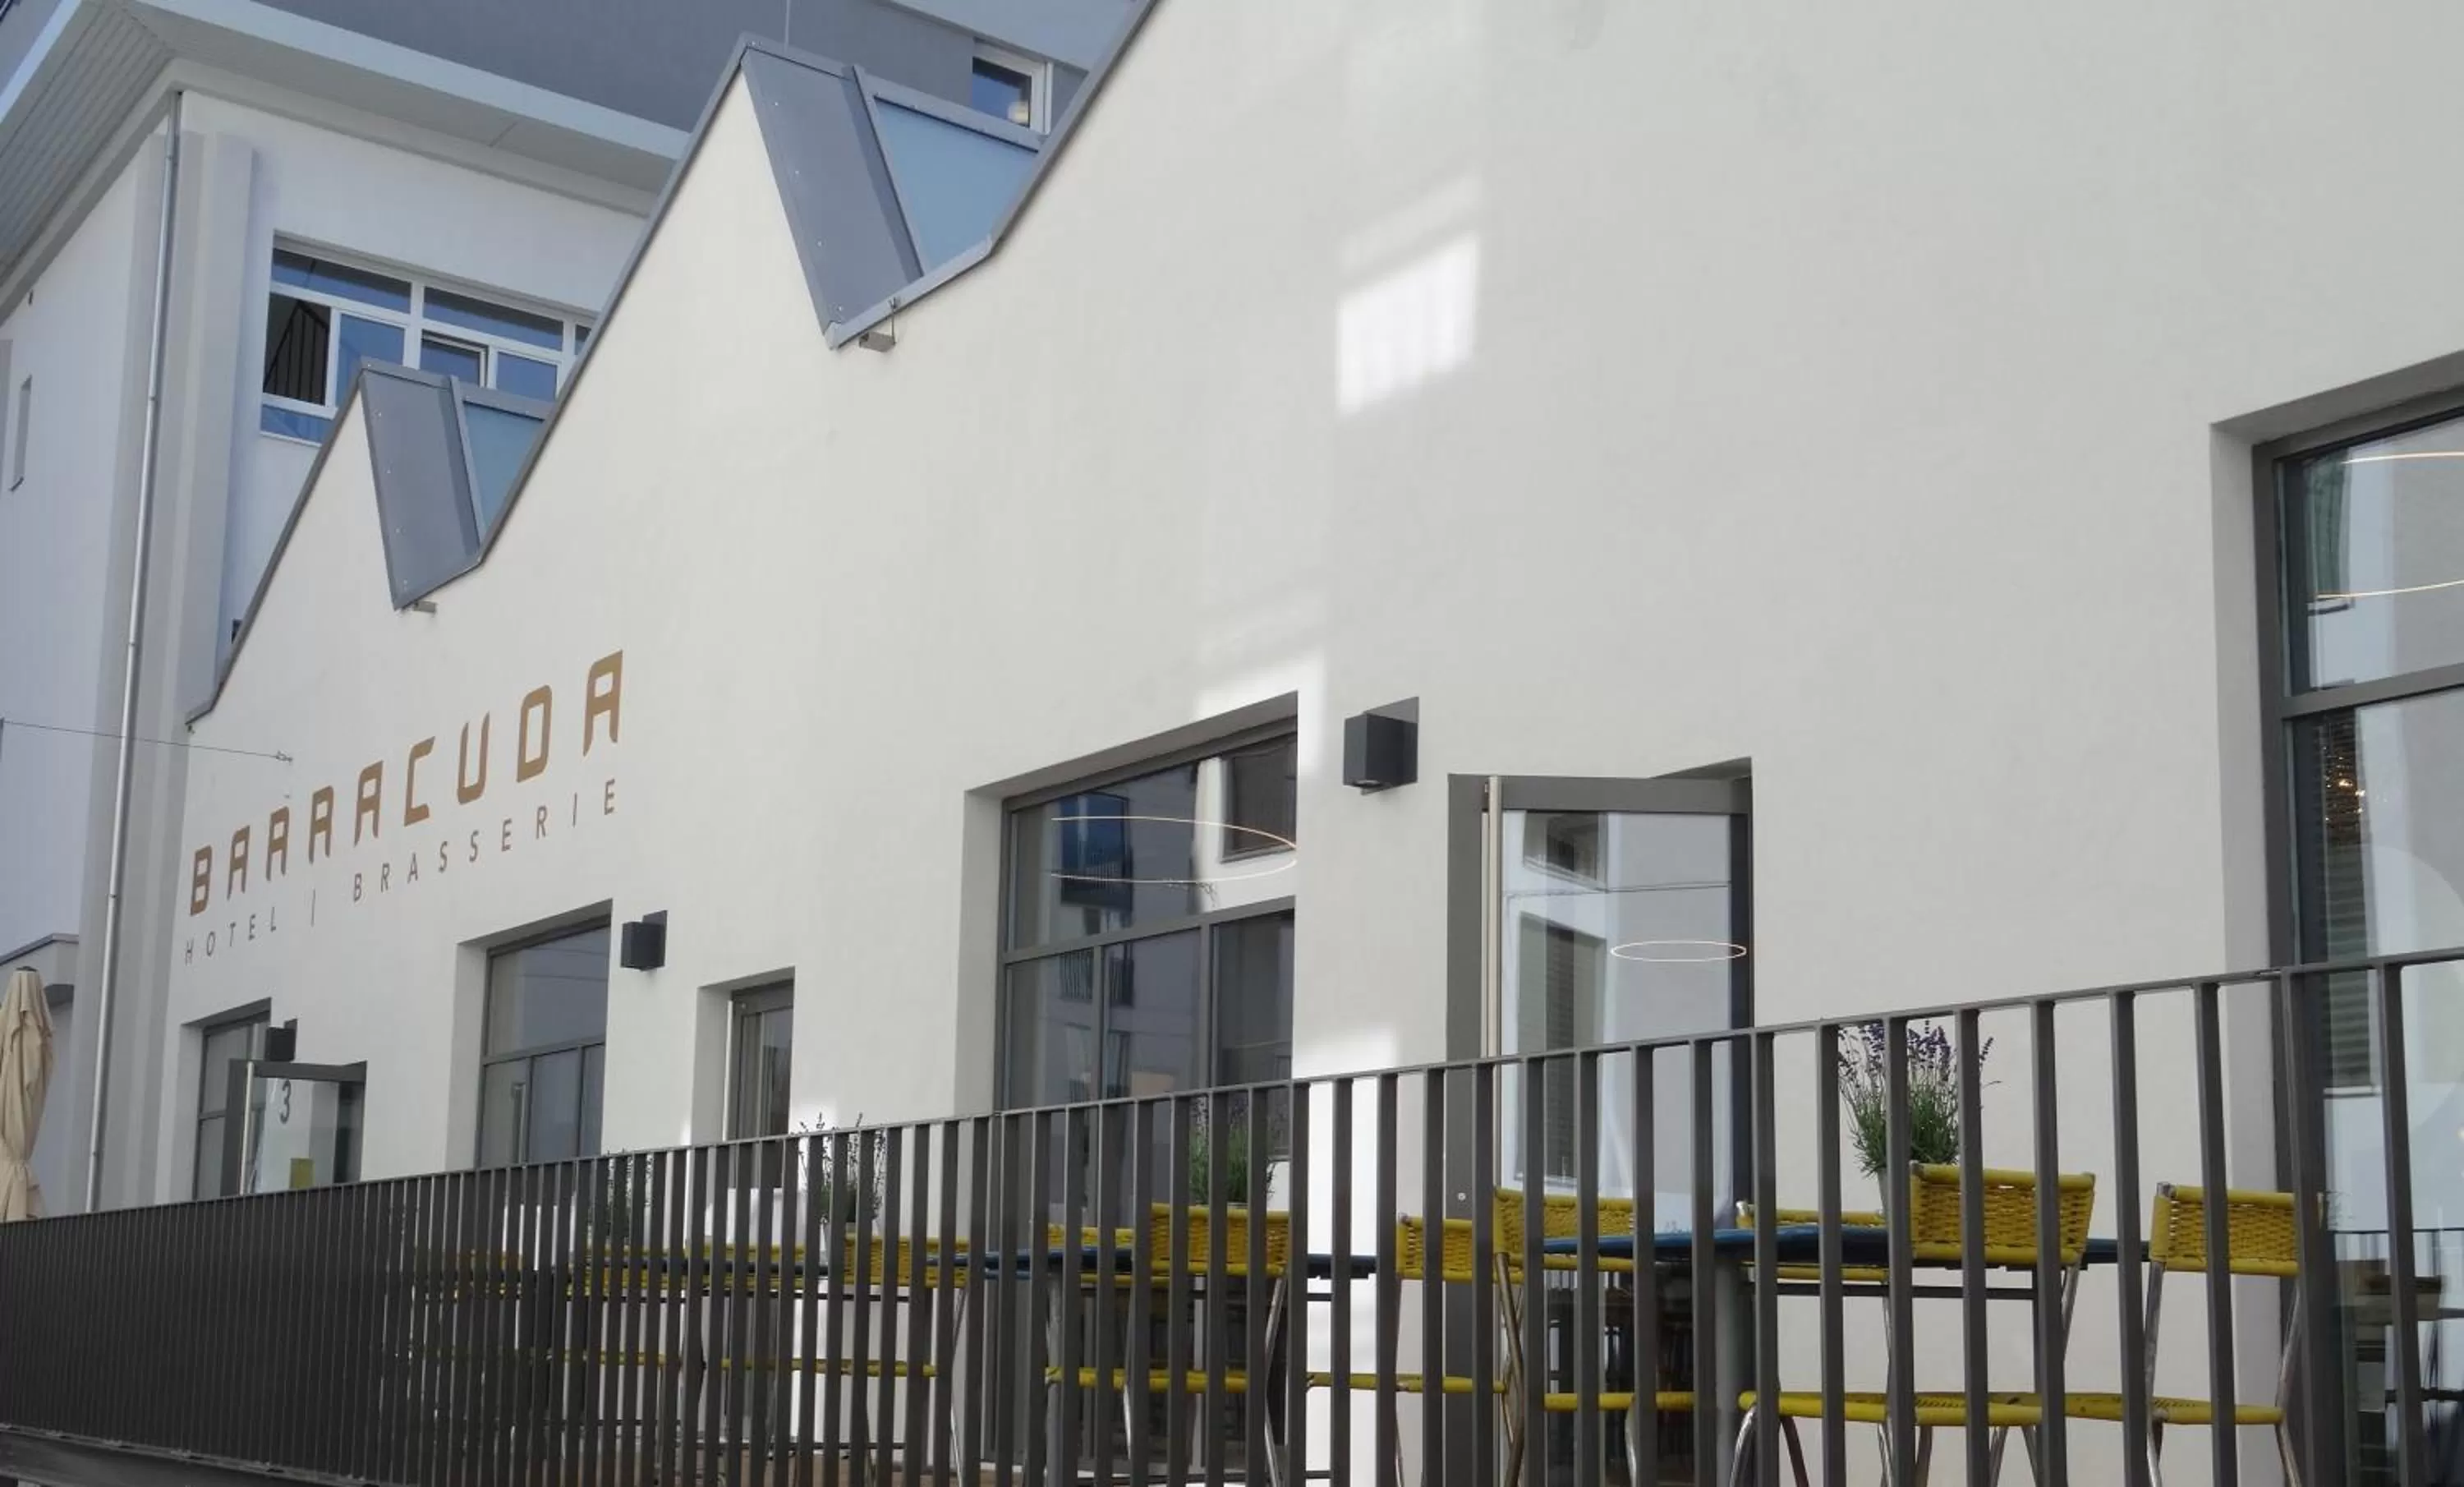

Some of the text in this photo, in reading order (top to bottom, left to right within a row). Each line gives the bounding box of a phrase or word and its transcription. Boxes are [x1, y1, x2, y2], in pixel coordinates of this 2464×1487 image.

[185, 906, 278, 966] HOTEL
[353, 778, 616, 905] BRASSERIE
[280, 1079, 292, 1125] 3
